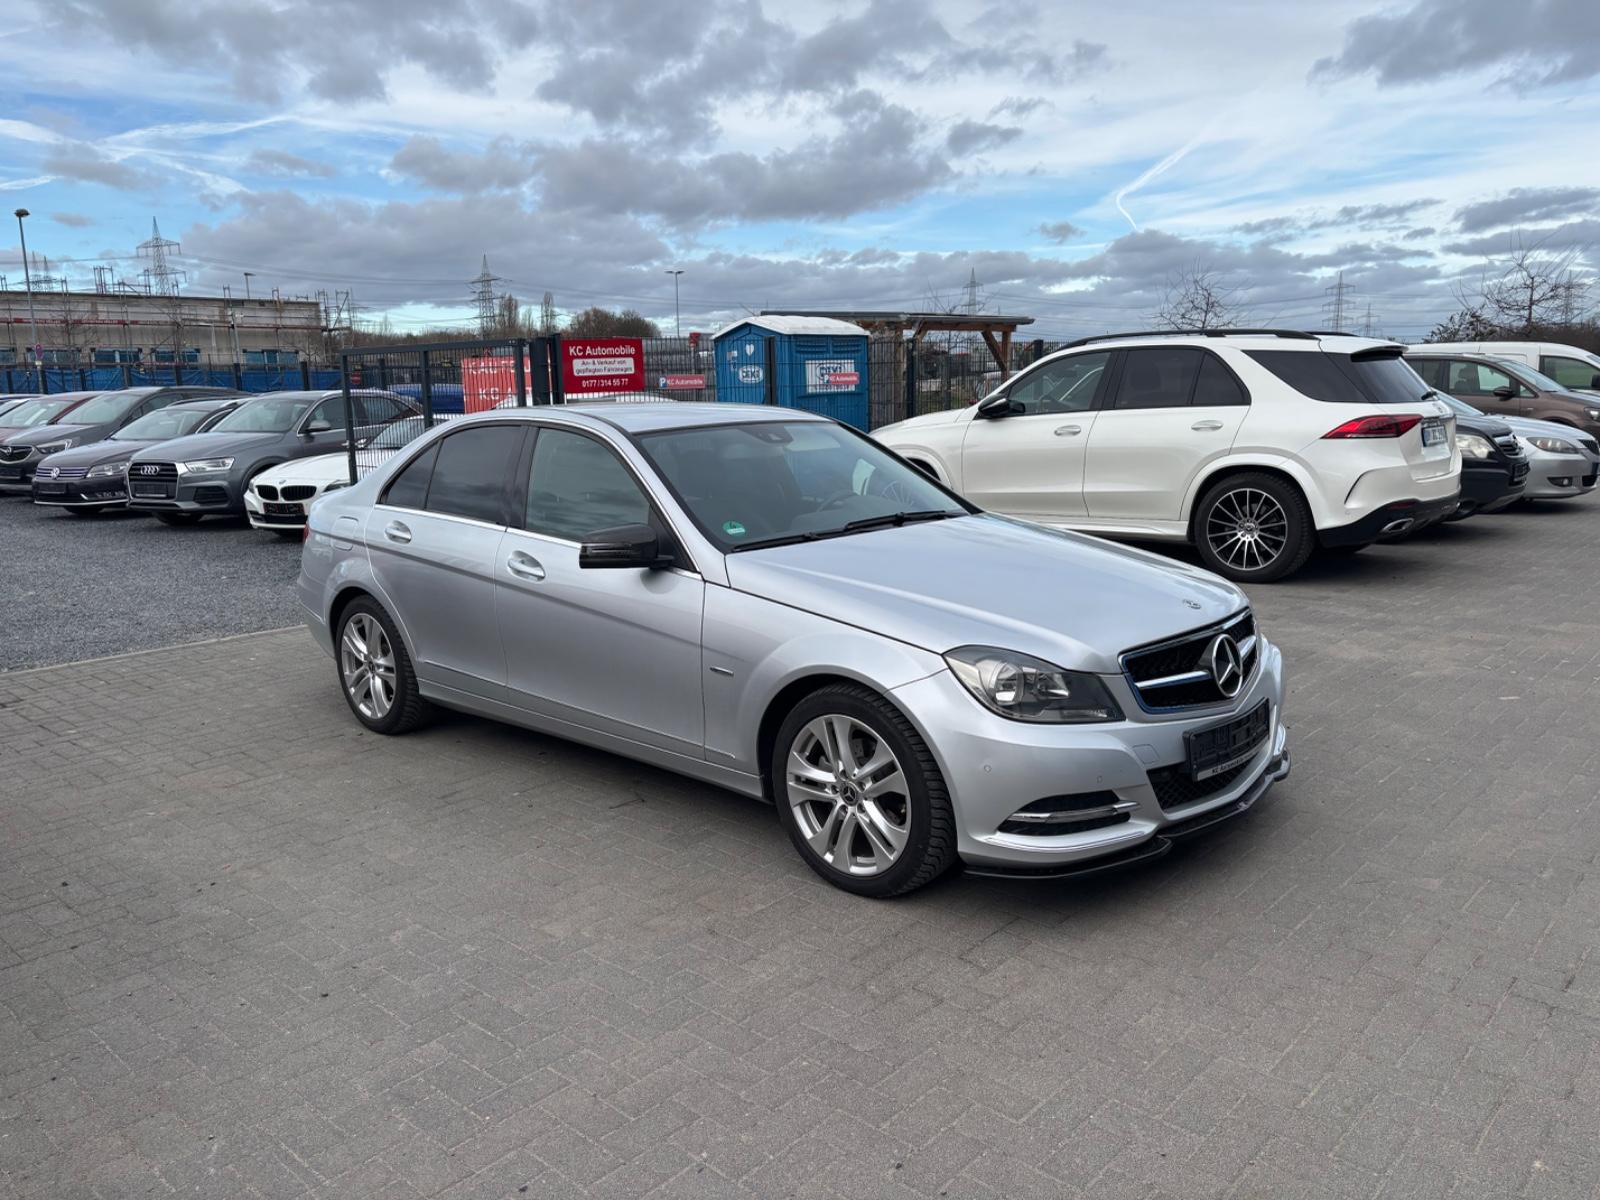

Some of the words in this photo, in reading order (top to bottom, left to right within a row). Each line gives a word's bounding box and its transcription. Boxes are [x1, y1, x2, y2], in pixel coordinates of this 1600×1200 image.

[569, 346, 584, 356] KC
[585, 345, 636, 356] Automobile
[621, 378, 629, 386] 77
